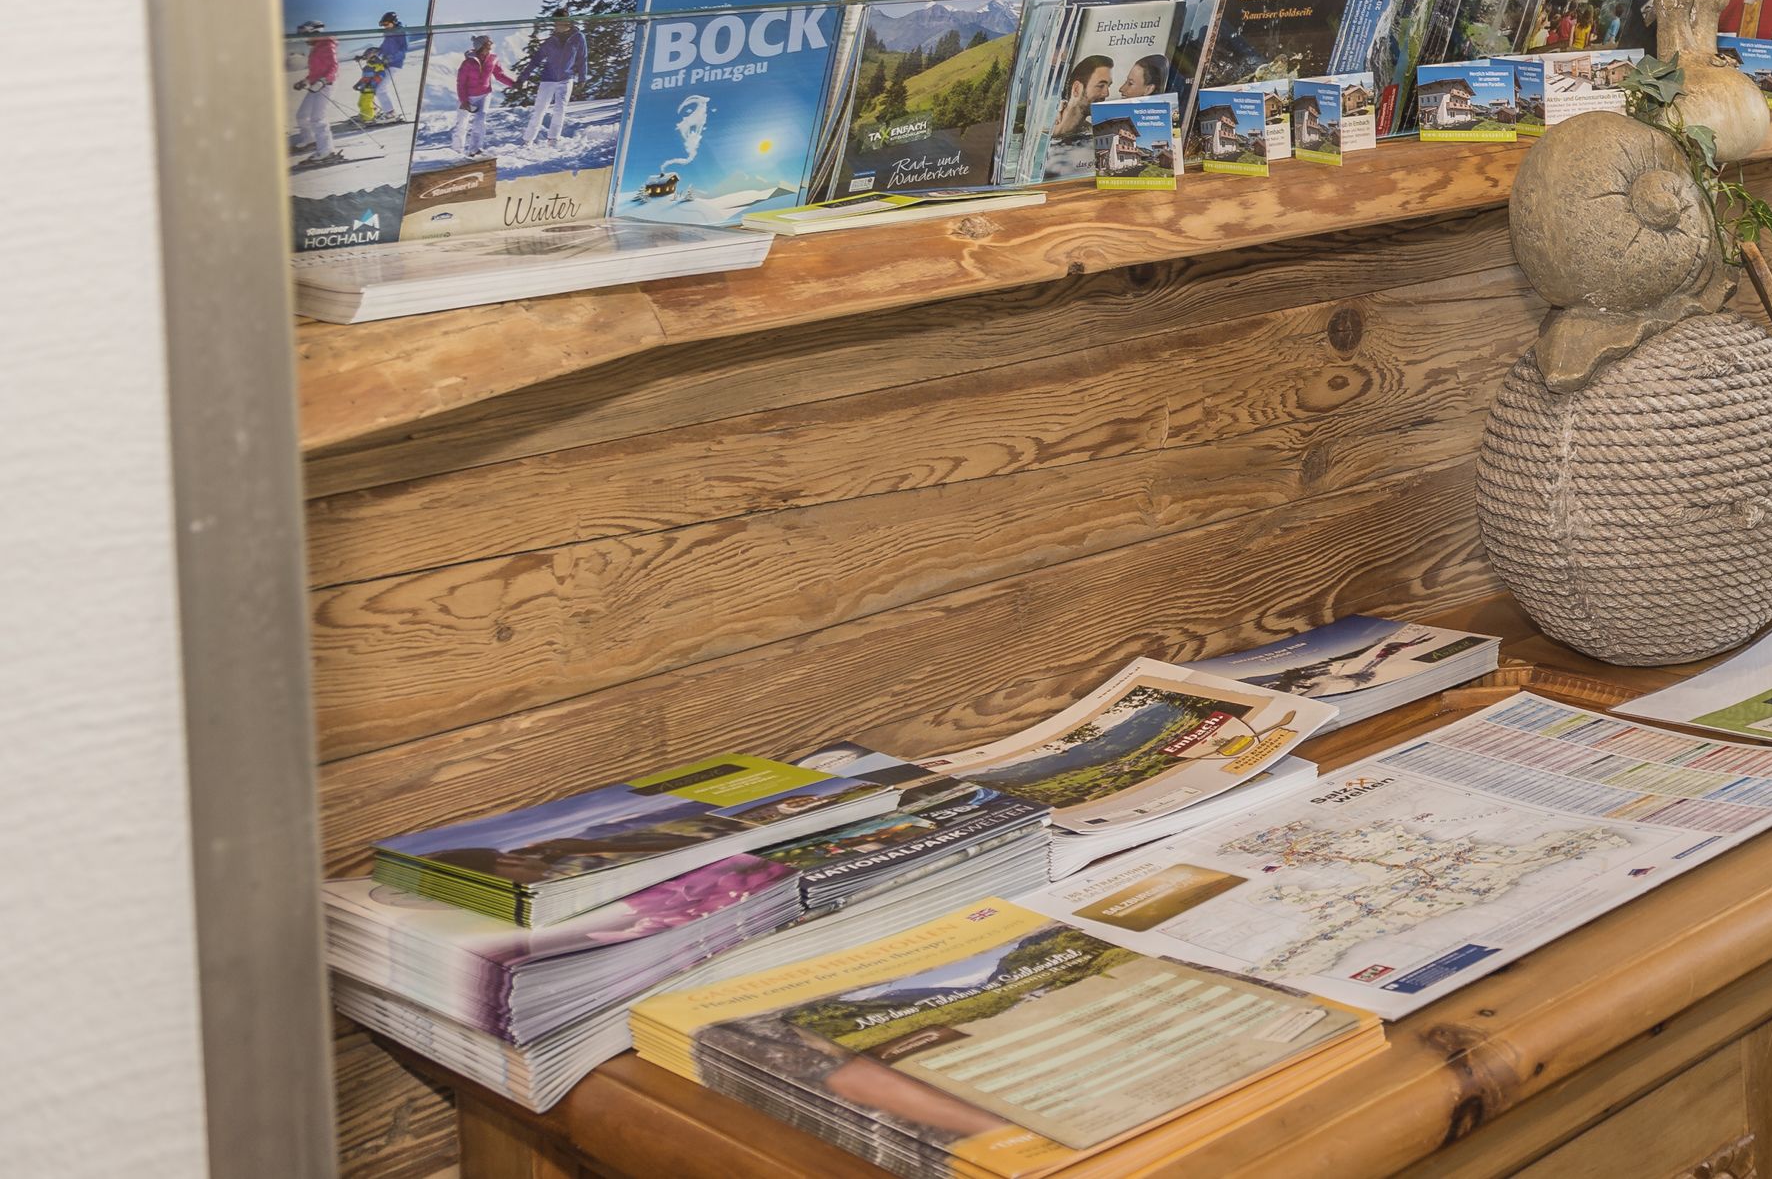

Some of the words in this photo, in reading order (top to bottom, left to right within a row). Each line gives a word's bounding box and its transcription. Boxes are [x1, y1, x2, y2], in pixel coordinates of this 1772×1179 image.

[1096, 21, 1138, 33] Erlebnis
[1140, 17, 1161, 30] und
[652, 3, 828, 74] BOCK
[1109, 33, 1156, 47] Erholung
[650, 71, 686, 91] auf
[690, 60, 769, 85] Pinzgau
[868, 121, 928, 145] TAXENBACH
[937, 151, 961, 167] und
[887, 165, 970, 189] Wanderkarte
[504, 192, 582, 227] Winter
[304, 230, 380, 249] HOCHALM
[307, 225, 350, 236] Rauriser
[1310, 787, 1350, 805] Salz
[1335, 777, 1395, 805] welten
[804, 805, 1035, 882] NATIONALPARKWELTEN
[688, 965, 812, 1002] GASTEINER
